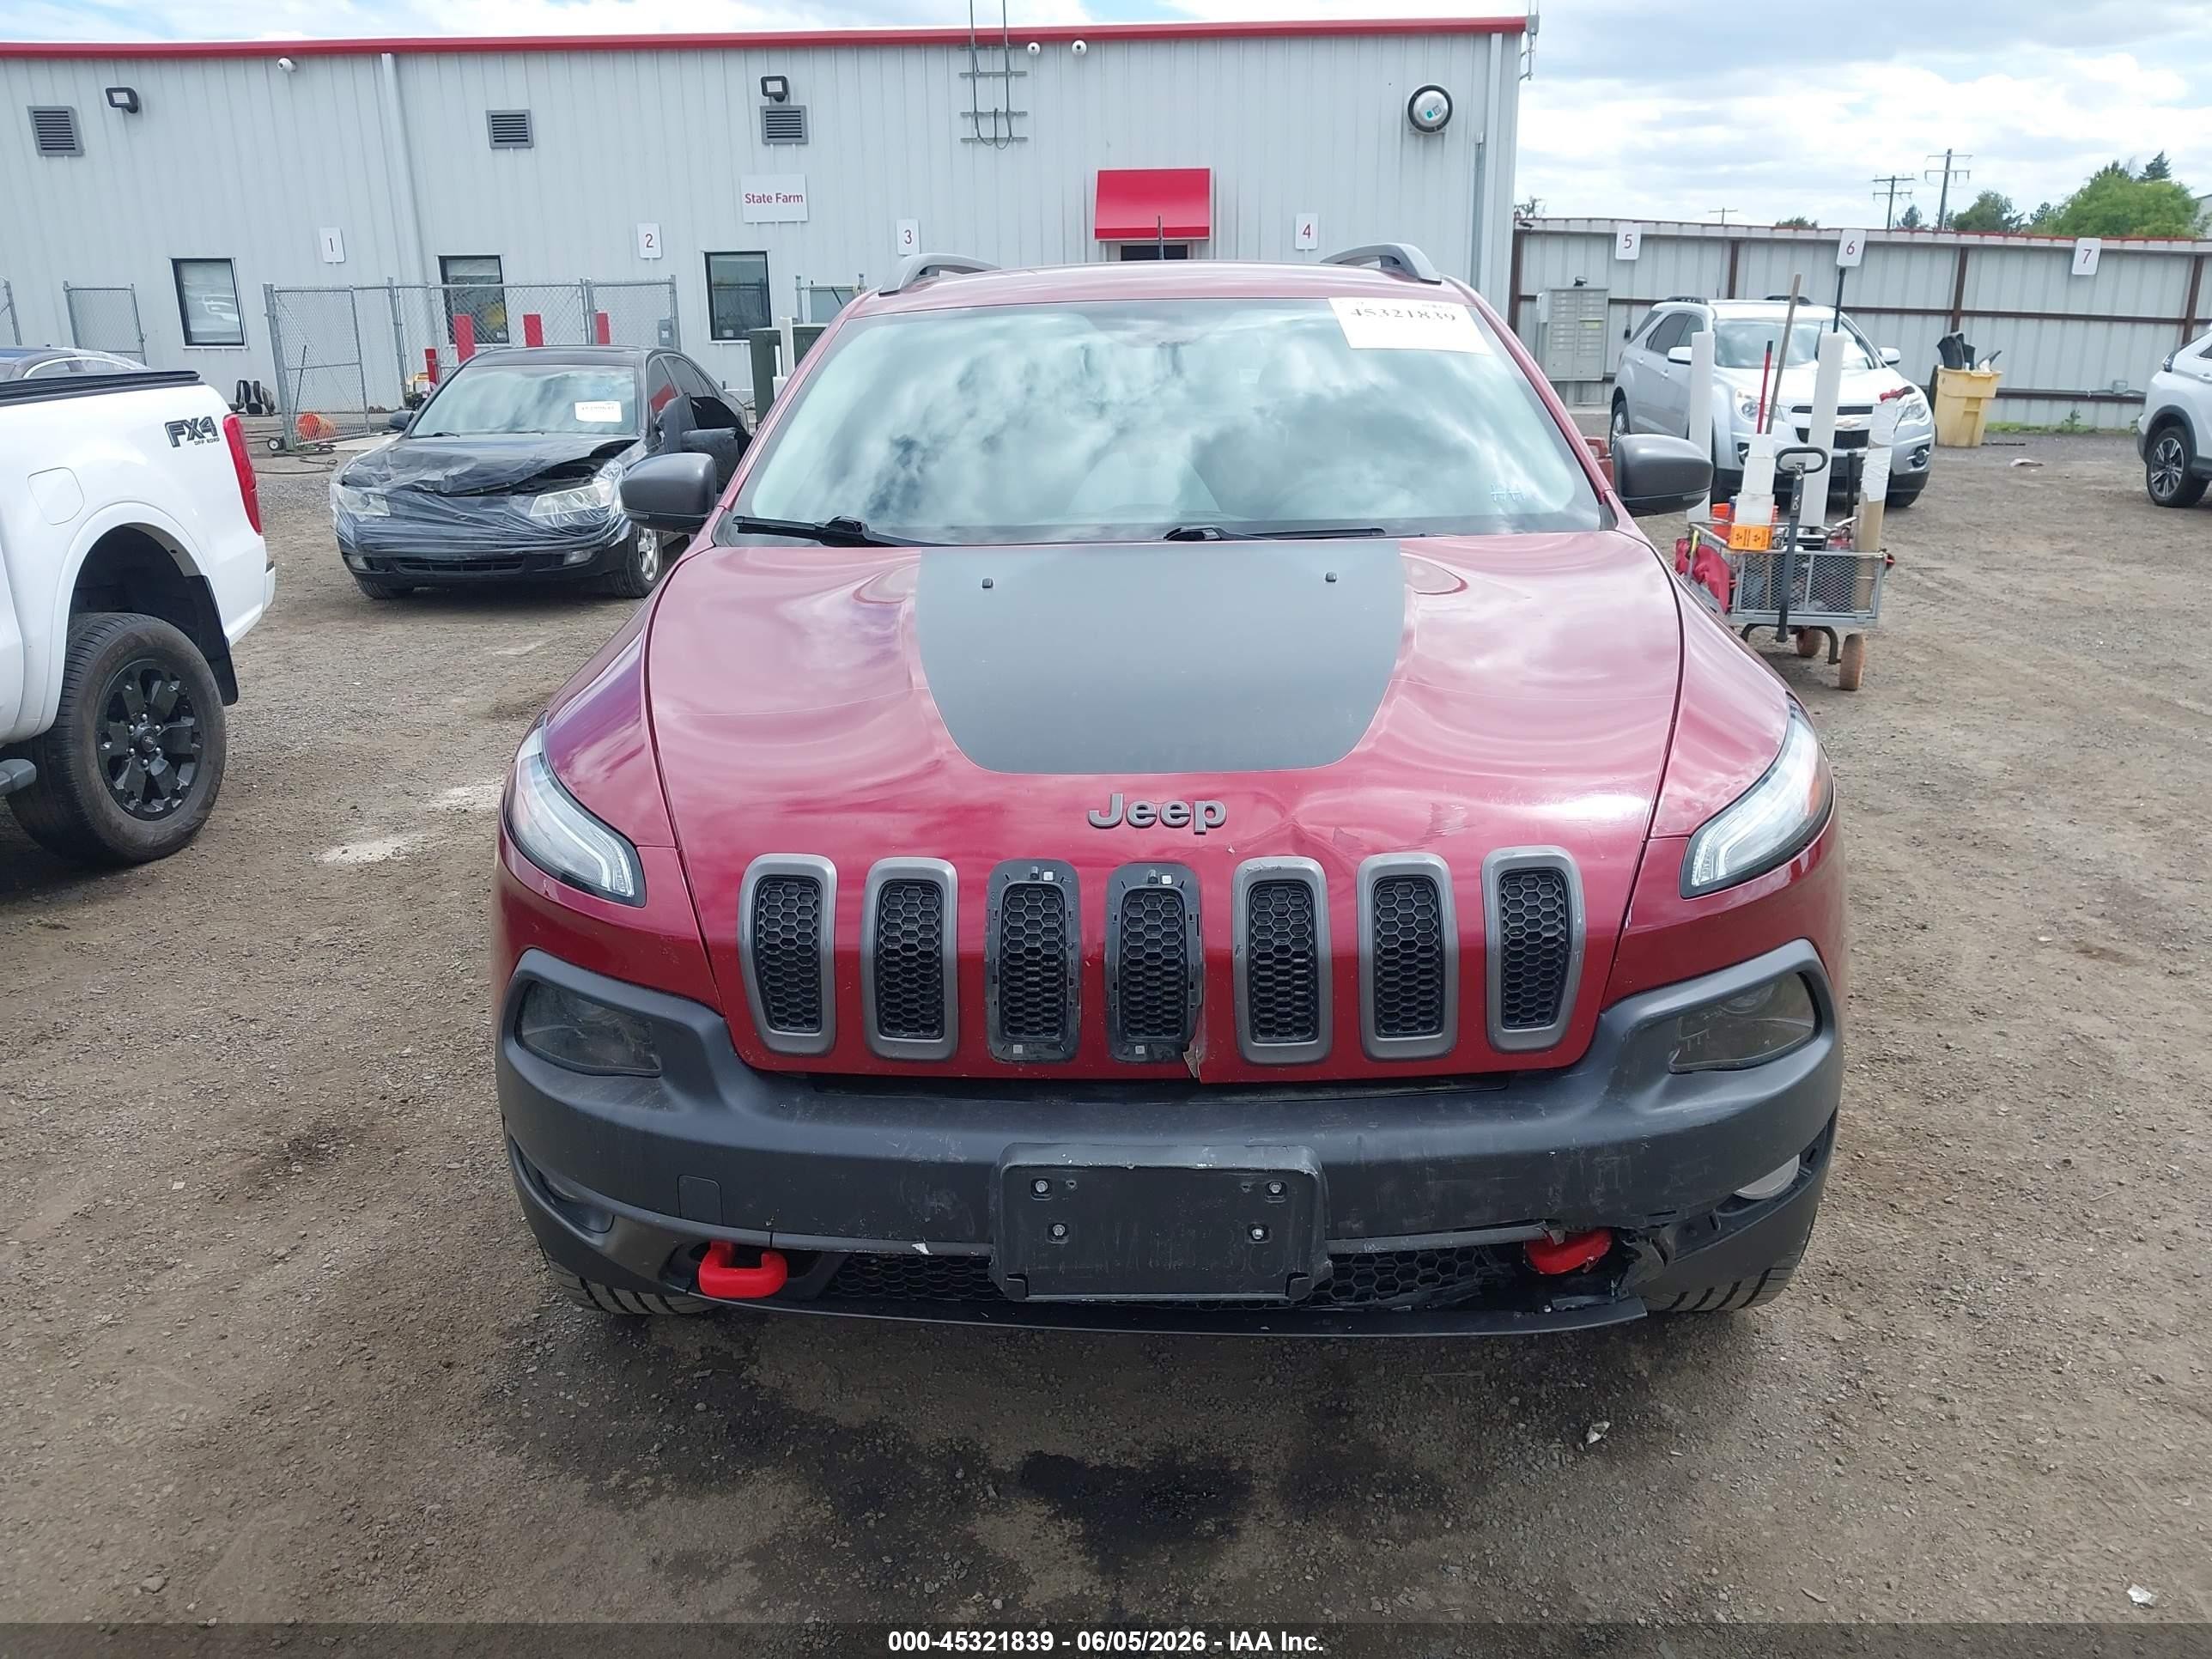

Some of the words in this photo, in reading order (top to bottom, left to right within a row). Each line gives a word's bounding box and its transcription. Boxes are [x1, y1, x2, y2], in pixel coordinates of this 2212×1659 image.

[744, 192, 773, 204] State
[775, 191, 804, 204] Farm
[904, 228, 913, 245] 3
[1302, 222, 1312, 239] 4
[329, 237, 334, 252] 1
[645, 233, 654, 249] 2
[1623, 234, 1633, 249] 5
[1846, 240, 1856, 256] 6
[2082, 248, 2094, 264] 7
[164, 416, 219, 448] FX4
[1087, 793, 1227, 836] Jeep
